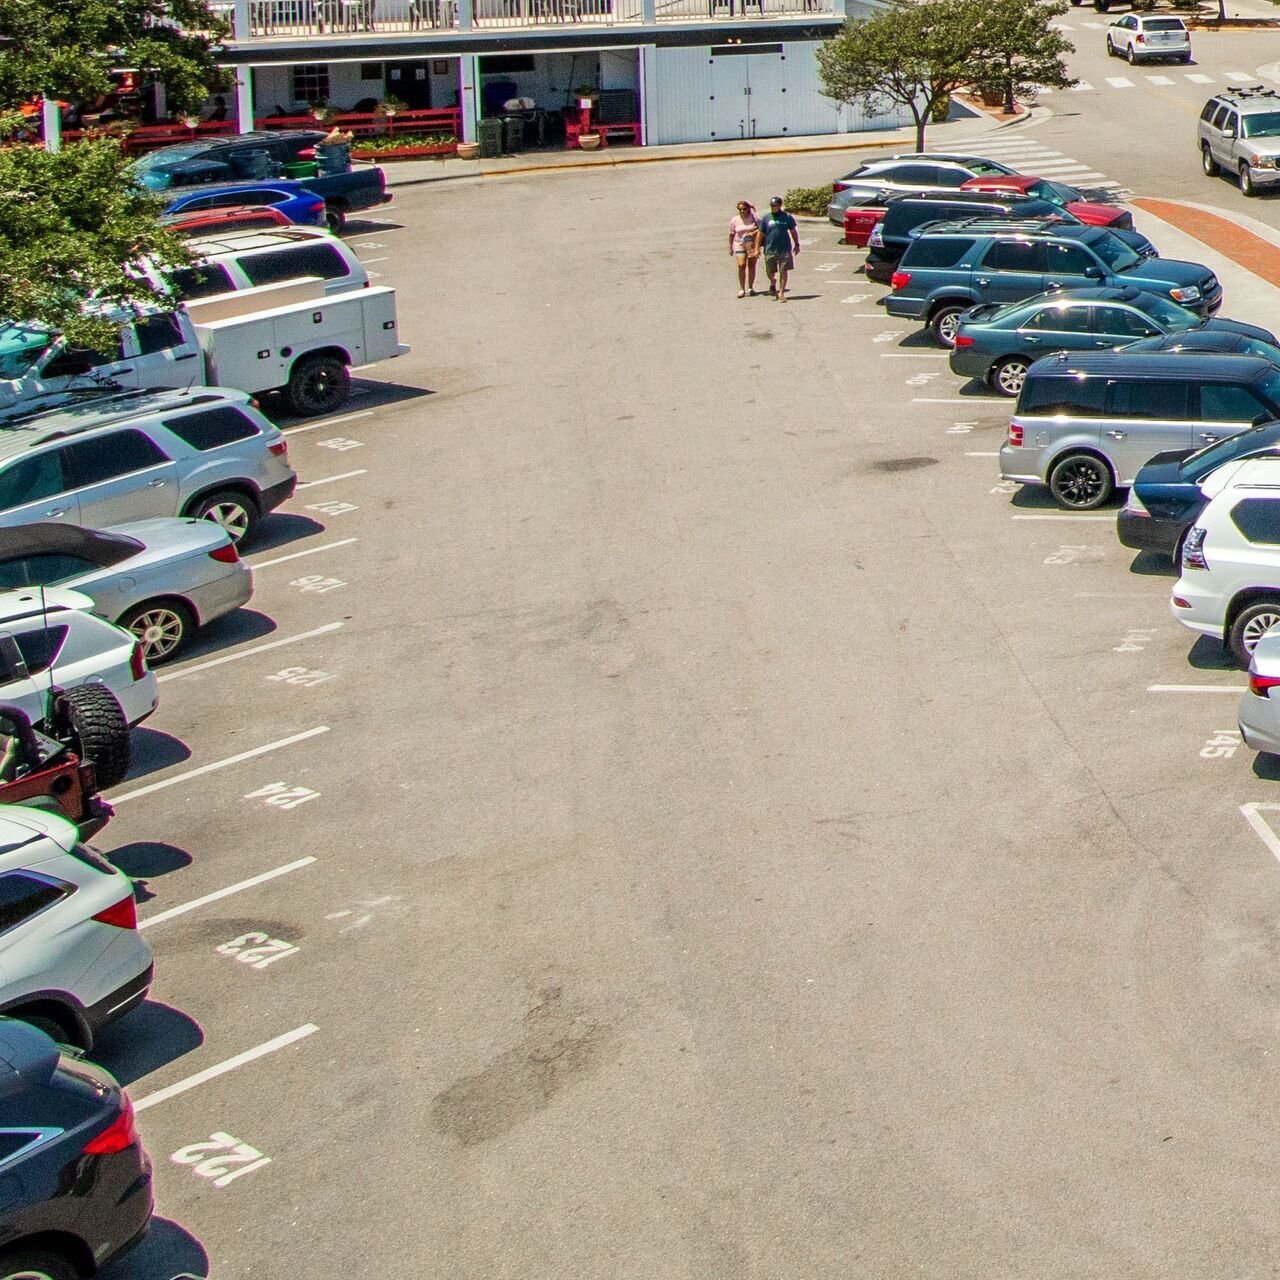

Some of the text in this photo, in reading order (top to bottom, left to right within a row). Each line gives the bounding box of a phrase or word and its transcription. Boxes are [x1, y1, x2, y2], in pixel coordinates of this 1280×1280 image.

[304, 500, 360, 516] 127
[288, 575, 349, 593] 126
[265, 666, 338, 687] 125
[1200, 729, 1242, 758] 145
[244, 781, 322, 809] 124
[215, 931, 300, 969] 123
[170, 1131, 273, 1187] 122
